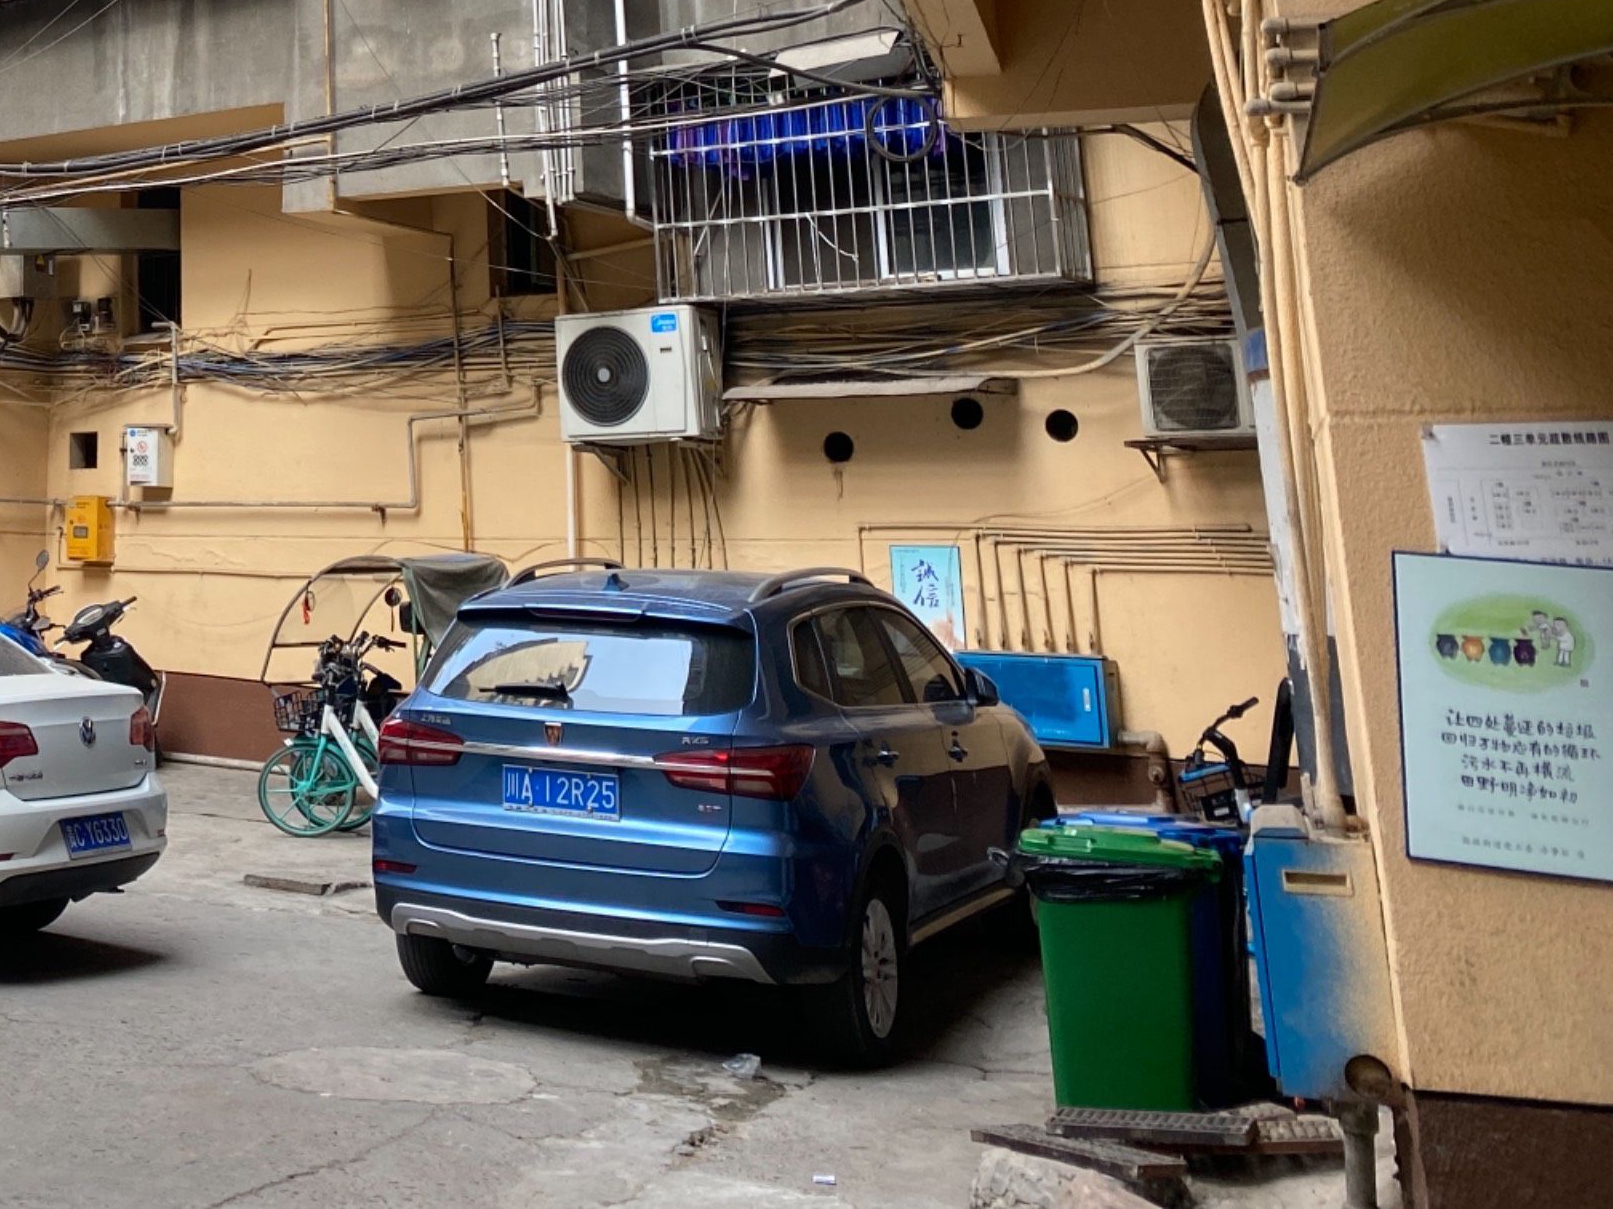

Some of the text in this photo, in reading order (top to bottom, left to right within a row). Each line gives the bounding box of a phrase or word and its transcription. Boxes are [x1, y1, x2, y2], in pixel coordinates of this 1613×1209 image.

[1446, 708, 1596, 740] 让四处蔓延的垃圾
[1441, 731, 1602, 760] 回归万物应有的循环
[1461, 753, 1576, 783] 污水不再横流
